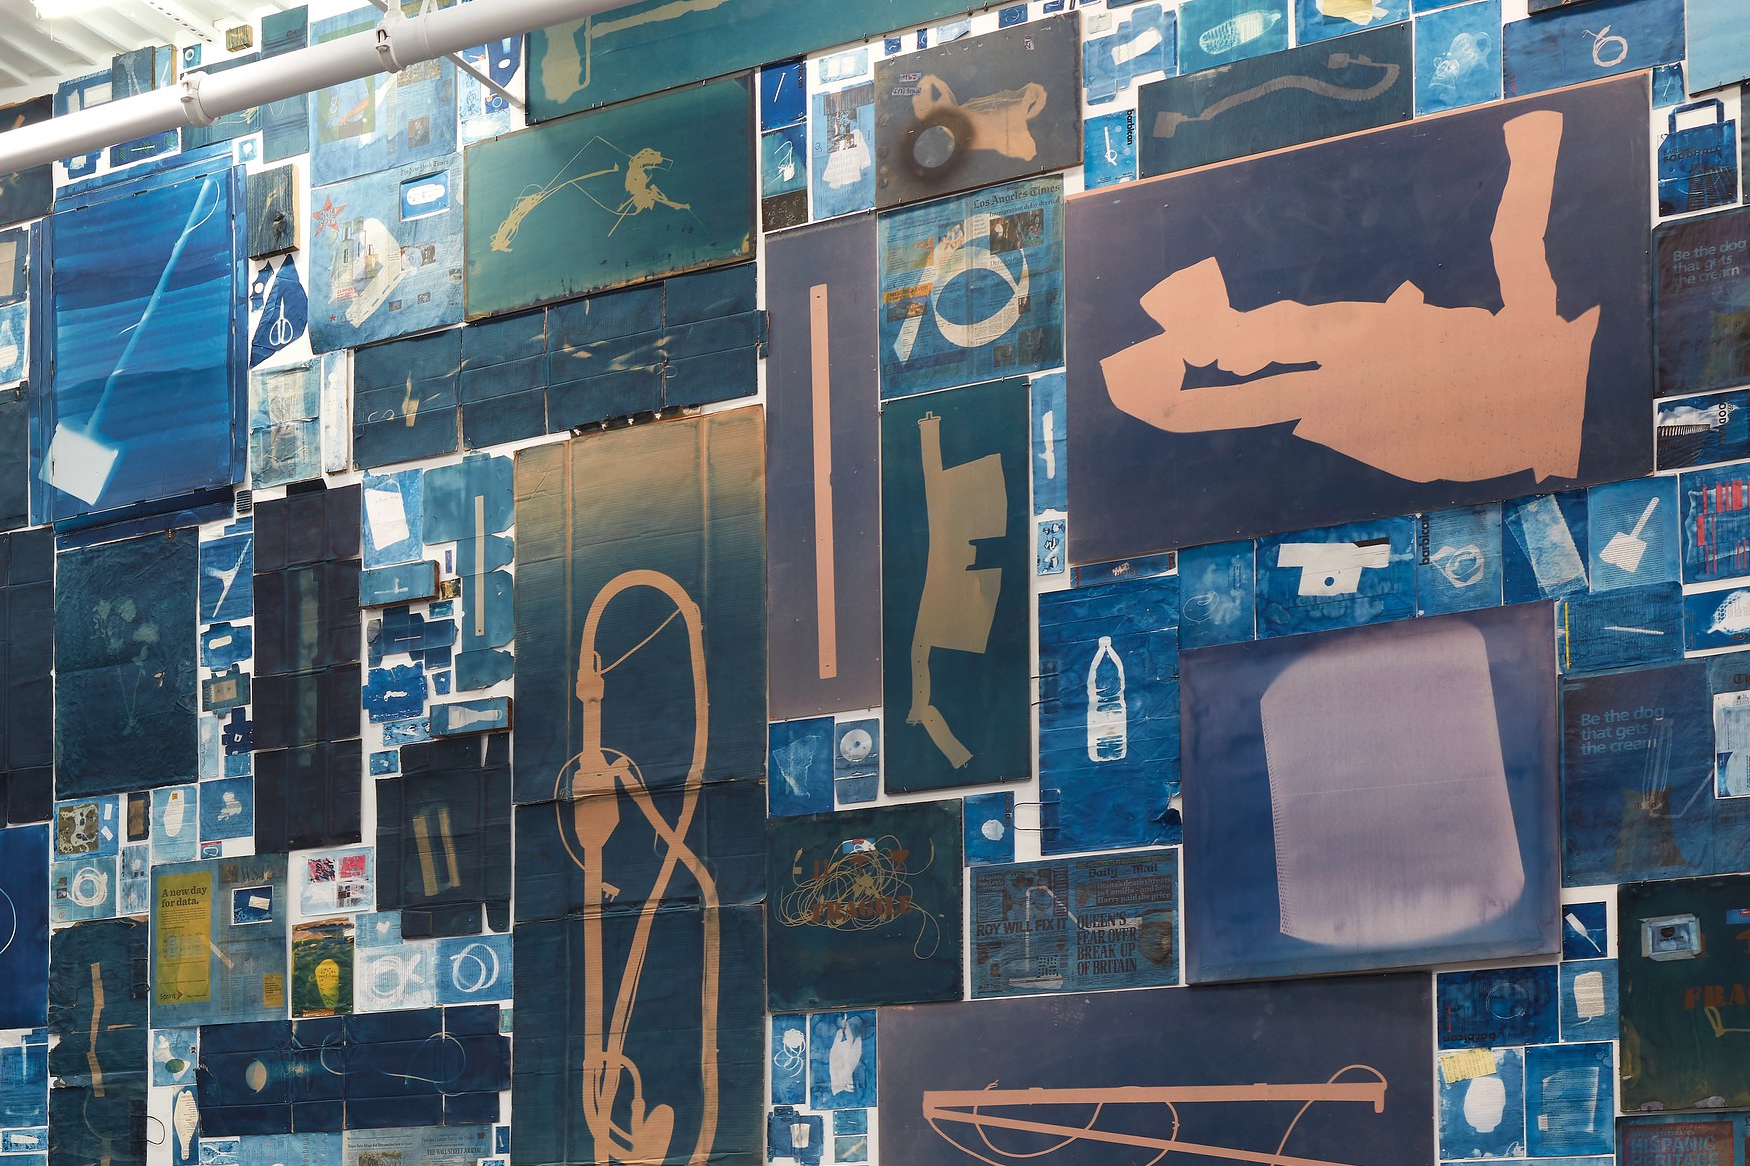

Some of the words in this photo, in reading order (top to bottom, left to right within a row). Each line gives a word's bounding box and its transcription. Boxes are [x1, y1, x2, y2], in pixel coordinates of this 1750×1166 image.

[1126, 109, 1134, 145] barbican
[973, 200, 990, 210] Los
[990, 190, 1028, 207] Angeles
[1029, 184, 1060, 199] Times
[1673, 250, 1690, 261] Be
[1693, 246, 1716, 258] the
[1720, 239, 1747, 254] dog
[1672, 260, 1700, 273] that
[1705, 254, 1731, 270] gets
[1675, 274, 1695, 286] the
[1699, 266, 1740, 282] cream
[1419, 515, 1430, 566] barbican
[1581, 713, 1600, 726] Be
[1604, 709, 1629, 723] the
[1633, 706, 1664, 721] dog
[1581, 727, 1612, 740] that
[1616, 724, 1649, 740] gets
[1580, 742, 1606, 756] the
[1610, 738, 1657, 753] cream
[1088, 869, 1118, 879] Daily
[1132, 863, 1158, 874] Mail
[161, 889, 169, 898] A
[169, 889, 189, 897] new
[190, 886, 208, 896] day
[161, 898, 176, 908] for
[176, 896, 199, 907] data.
[812, 895, 913, 924] FRAGILE
[977, 922, 1001, 937] ROY
[1003, 920, 1033, 934] WILL
[1035, 918, 1054, 931] FIX
[1057, 917, 1067, 930] IT
[1077, 911, 1127, 930] QUEEN'S
[1077, 929, 1106, 945] FEAR
[1108, 927, 1137, 942] OVER
[1077, 945, 1116, 960] BREAK
[1121, 943, 1135, 957] UP
[1077, 960, 1090, 976] OF
[1093, 958, 1137, 974] BRITAIN
[160, 990, 176, 1001] Sprint
[1684, 983, 1750, 1009] FRA
[1632, 1136, 1716, 1154] HISPANIC
